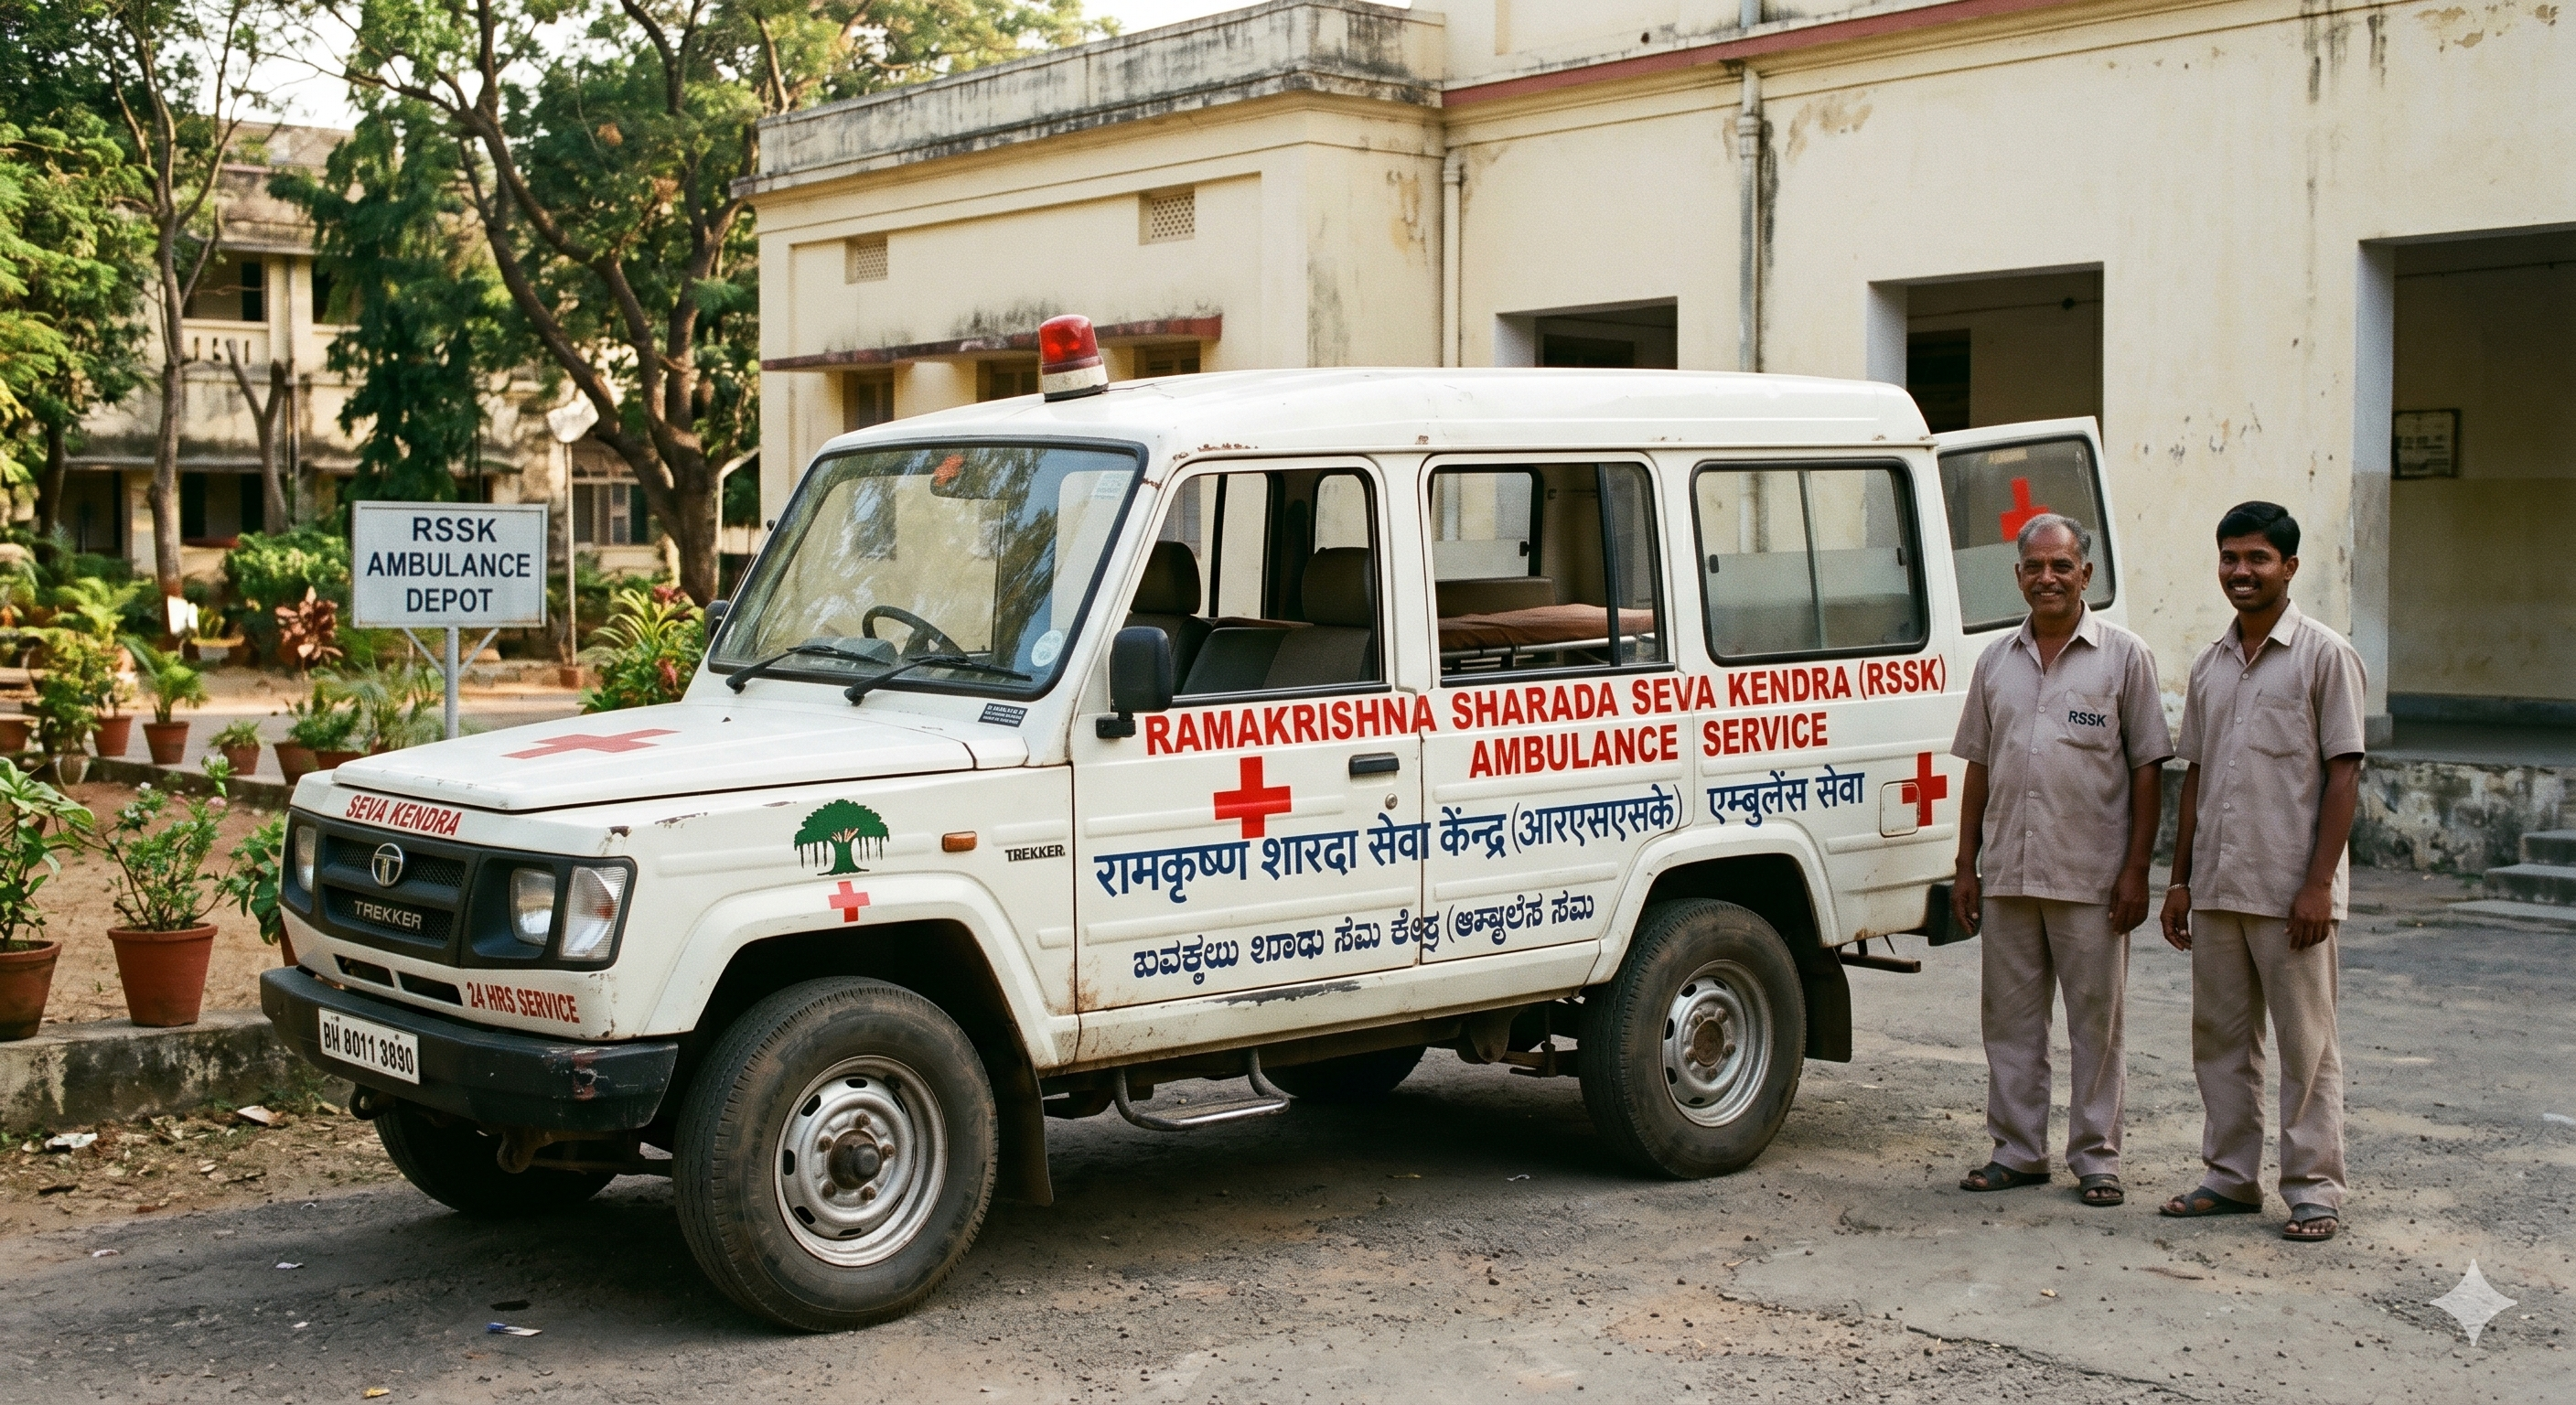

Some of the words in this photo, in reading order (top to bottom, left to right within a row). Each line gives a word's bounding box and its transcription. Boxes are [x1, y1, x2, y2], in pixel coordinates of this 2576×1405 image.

[413, 517, 497, 542] RSSK
[367, 552, 531, 577] AMBULANCE
[406, 588, 493, 612] DEPOT
[1144, 696, 1438, 756] RAMAKRISHNA
[1451, 681, 1619, 730] SHARADA
[1631, 675, 1717, 716] SEVA
[1727, 665, 1852, 708] KENDRA
[1858, 654, 1947, 701] (RSSK)
[2068, 710, 2108, 728] RSSK
[1469, 724, 1679, 779] AMBULANCE
[1702, 712, 1829, 757] SERVICE
[345, 794, 387, 821] SEVA
[388, 800, 462, 836] KENDRA
[1706, 769, 1809, 827] एम्बुलेंस
[1815, 763, 1865, 809] सेवा
[1093, 841, 1250, 904] रामकृष्ण
[1261, 830, 1359, 881] शारदा
[1367, 812, 1432, 865] सेवा
[1511, 783, 1683, 854] (आरएसएसके)
[354, 899, 423, 930] TREKKER
[466, 981, 485, 1010] 24
[487, 984, 516, 1014] HRS
[516, 989, 580, 1024] SERVICE
[323, 1021, 341, 1053] BH
[344, 1027, 375, 1064] 8011
[380, 1038, 414, 1075] 3890
